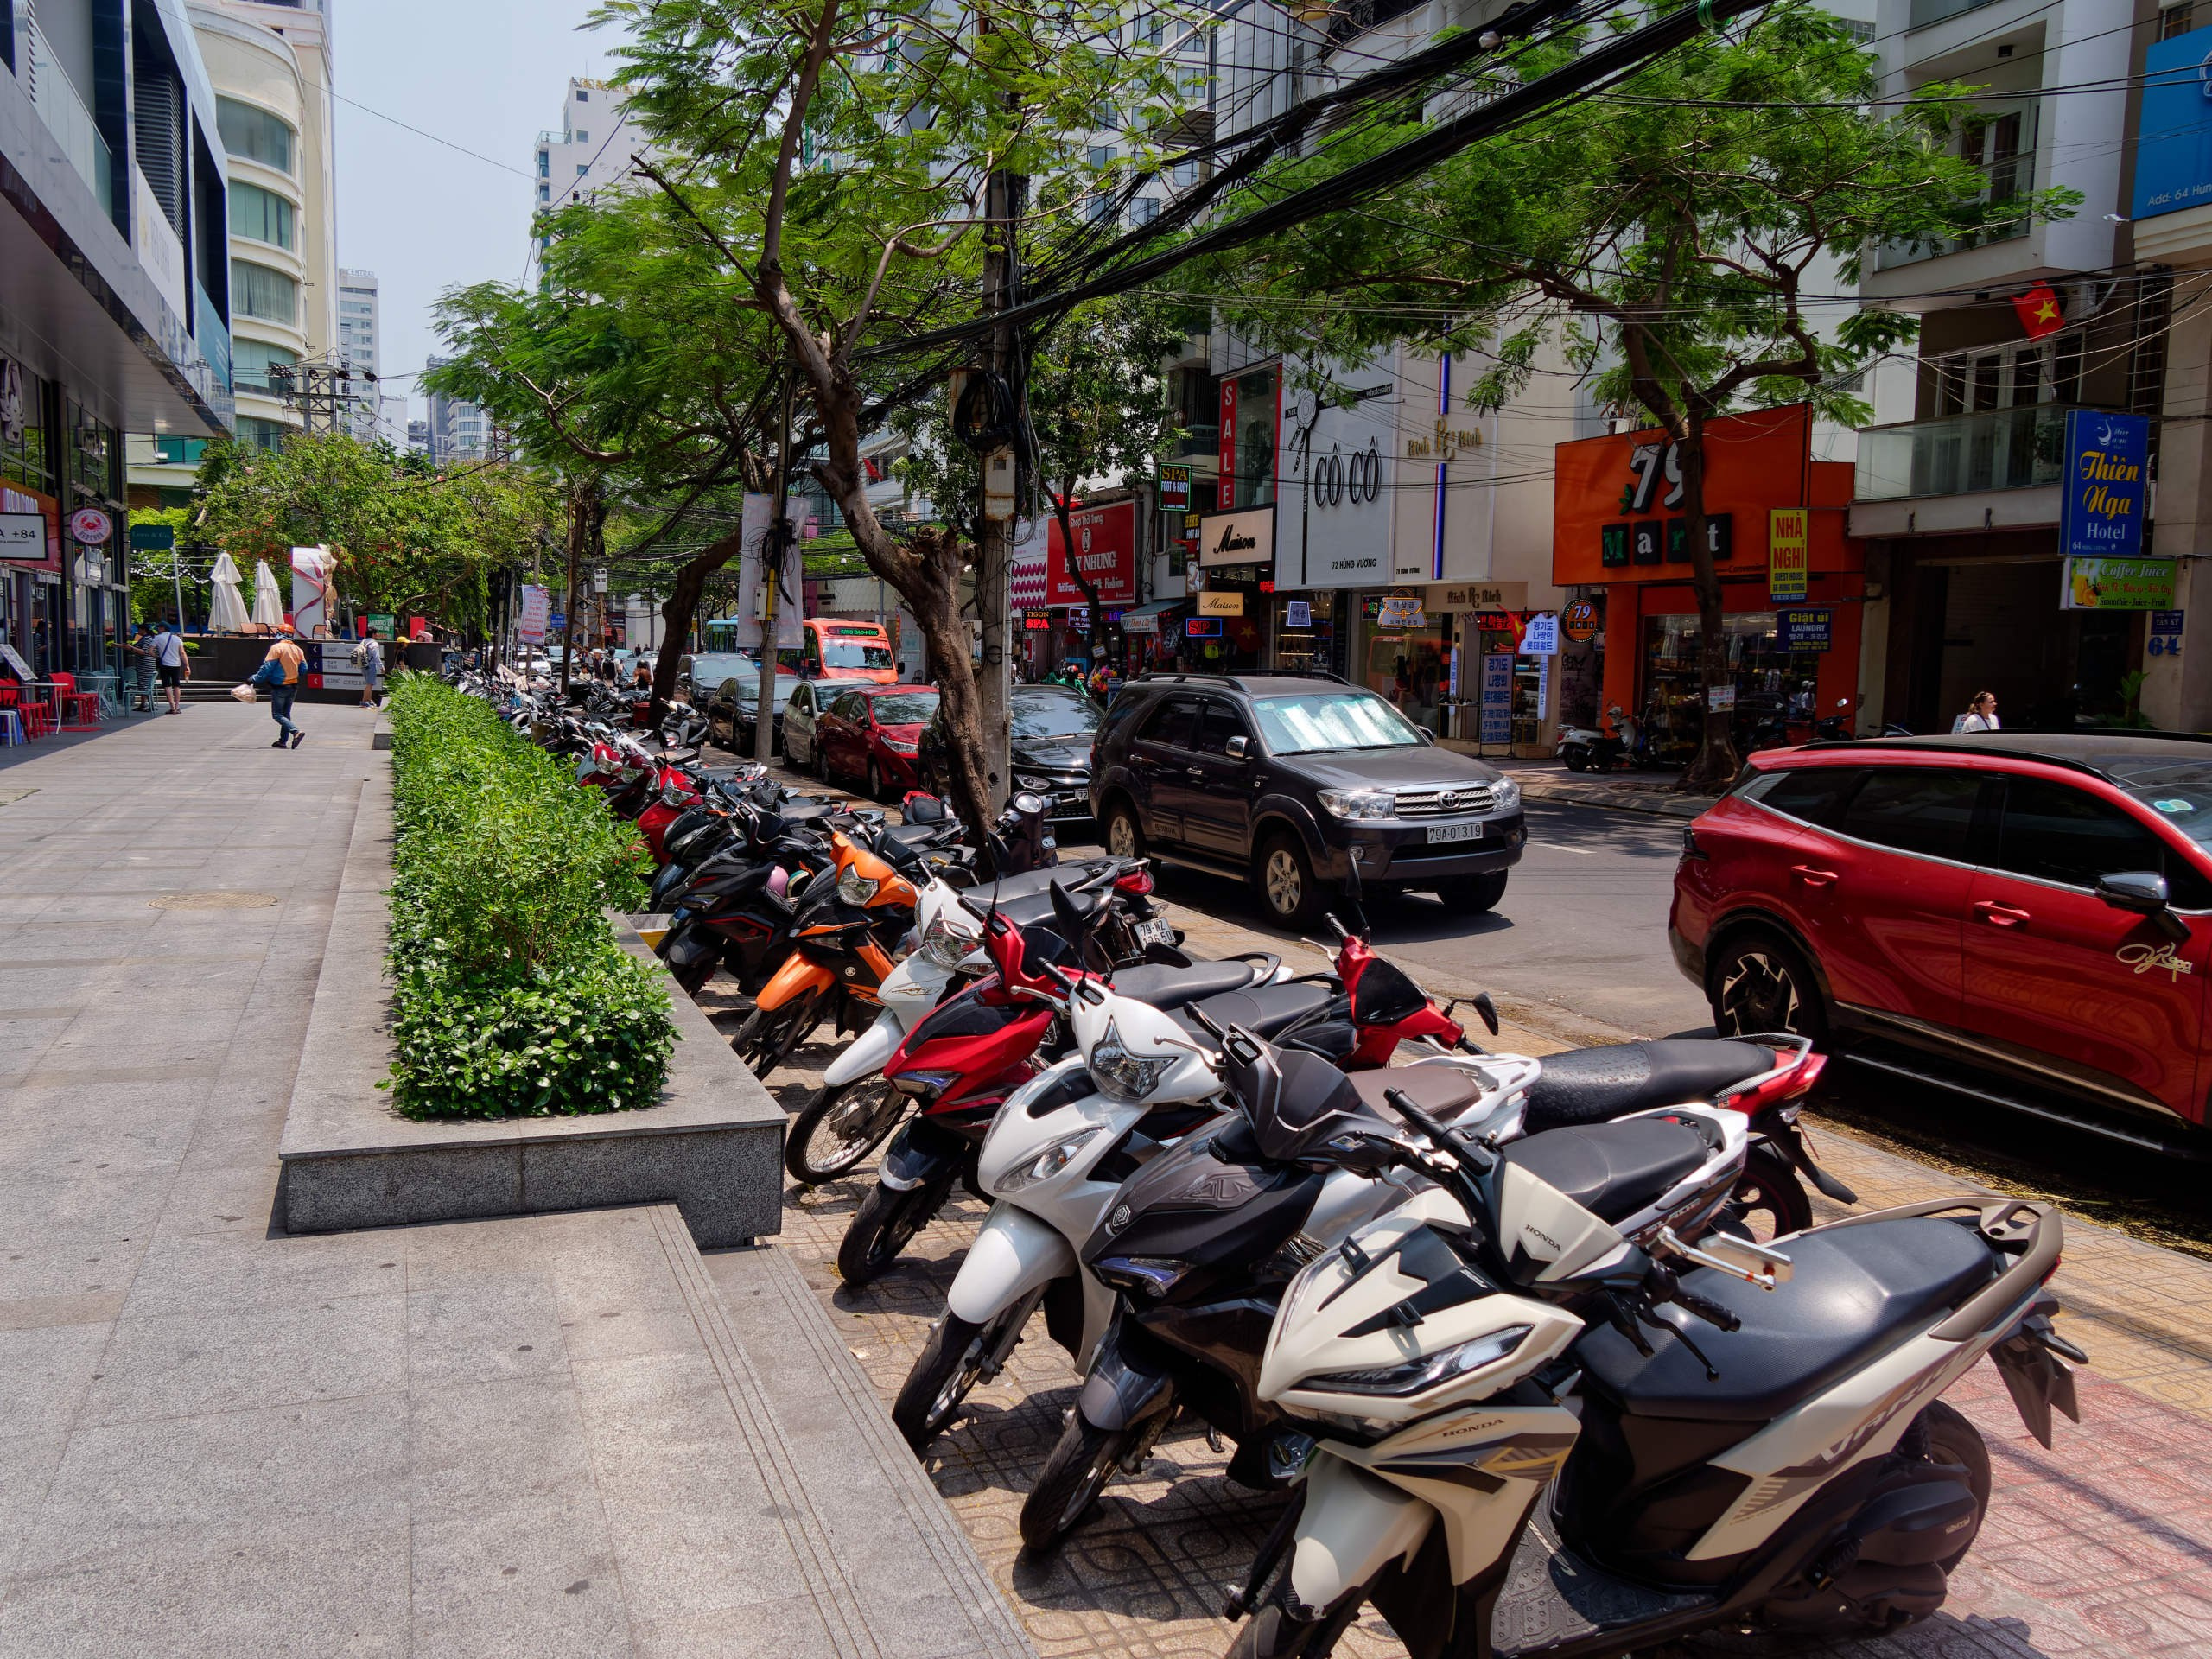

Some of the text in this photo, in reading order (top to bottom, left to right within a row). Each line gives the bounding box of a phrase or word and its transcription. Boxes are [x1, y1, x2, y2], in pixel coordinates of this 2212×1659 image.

[2174, 188, 2189, 200] 64
[1224, 385, 1234, 505] SALE
[1408, 435, 1430, 456] Rich
[1161, 467, 1189, 481] SPA
[1314, 442, 1342, 508] CÔ
[1349, 435, 1380, 505] CÔ
[2079, 450, 2139, 482] Thiên
[1160, 480, 1172, 492] FOOT
[2082, 485, 2133, 520] Nga
[12, 530, 35, 539] +84
[1776, 512, 1803, 539] NHÀ
[2086, 522, 2126, 540] Hotel
[1213, 524, 1257, 554] Maison
[1603, 523, 1719, 561] Mart
[1083, 550, 1117, 572] NHUNG
[1773, 539, 1806, 569] NGHỈ
[1332, 561, 1338, 570] 72
[1339, 557, 1355, 569] HÙNG
[2101, 562, 2169, 580] Coffee Juice
[1202, 597, 1240, 610] Maison
[1447, 591, 1466, 604] Rich
[1482, 589, 1502, 603] Rich
[2100, 597, 2128, 606] Smoothie
[1573, 605, 1592, 620] 79
[1025, 618, 1051, 630] SPA
[1533, 621, 1554, 631] 경기도
[1791, 624, 1826, 632] LAUNDRY
[2148, 635, 2182, 657] 64
[1488, 658, 1508, 671] 경기도
[1525, 1223, 1562, 1252] HONDA
[1442, 1418, 1506, 1438] HONDA
